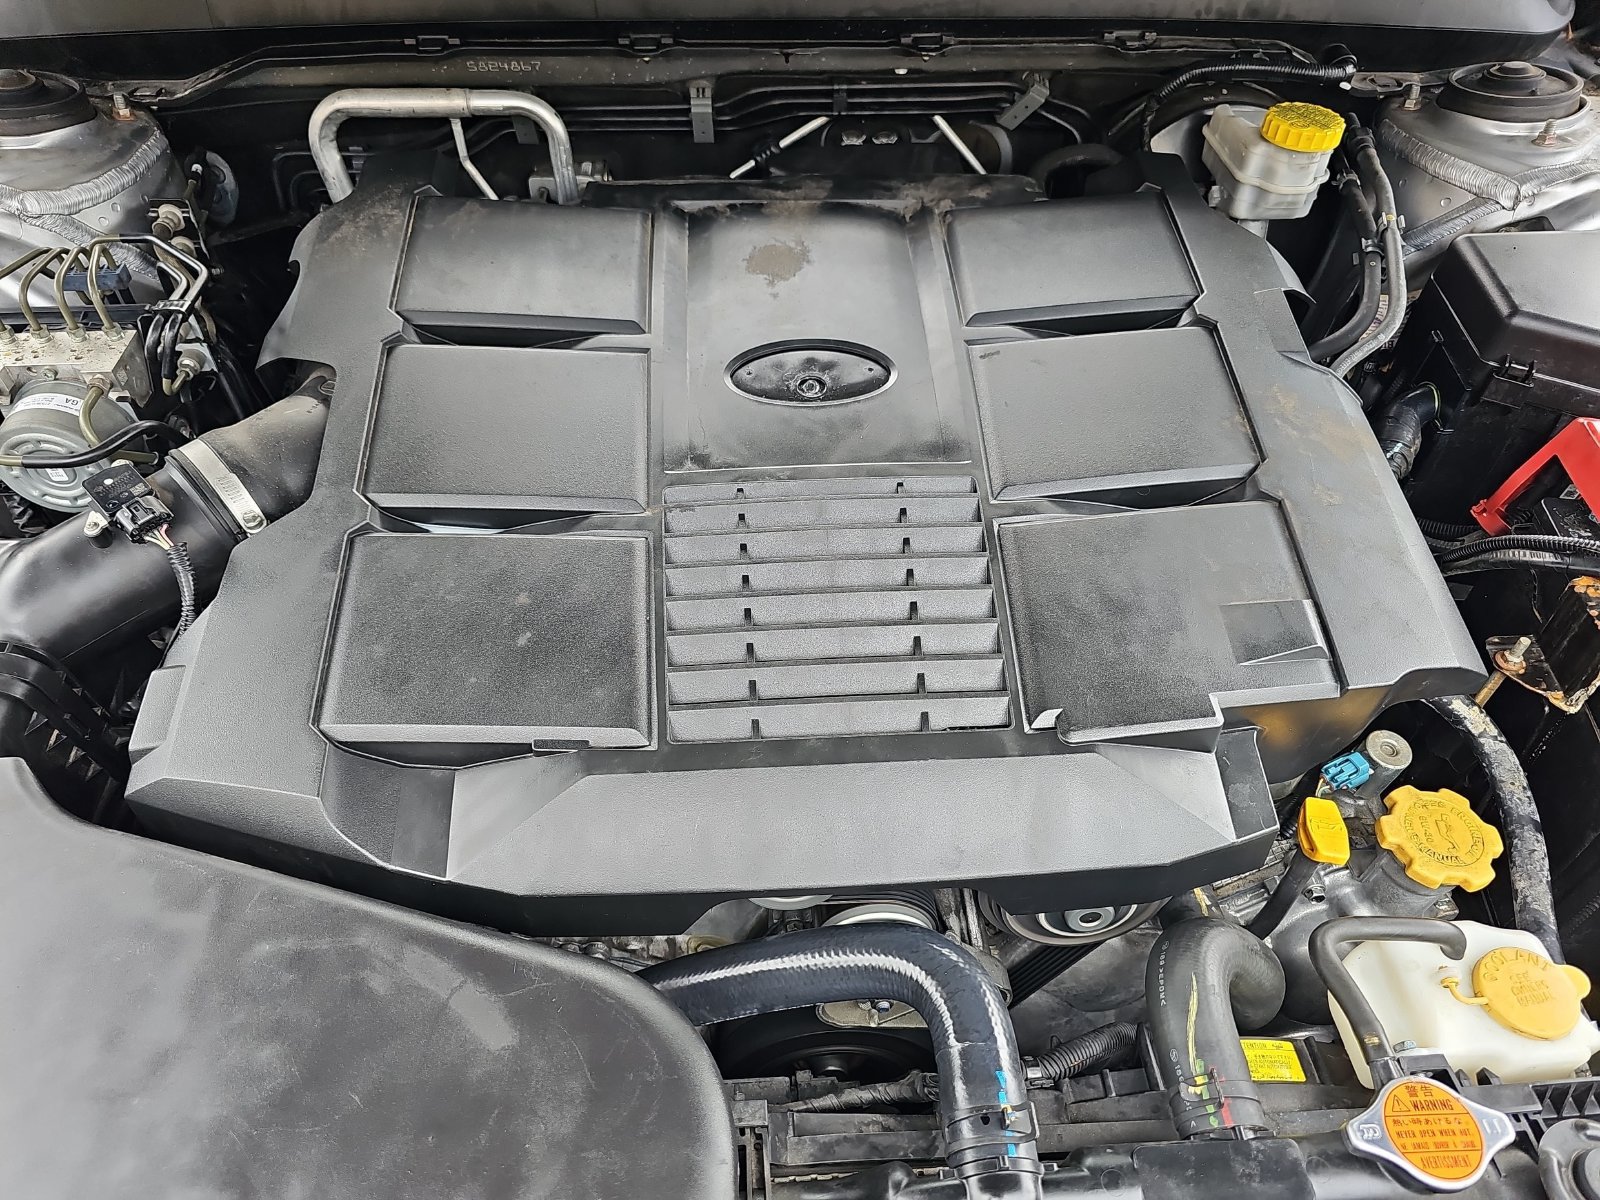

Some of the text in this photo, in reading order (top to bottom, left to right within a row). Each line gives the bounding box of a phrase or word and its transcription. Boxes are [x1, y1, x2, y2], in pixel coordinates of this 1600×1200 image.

[65, 397, 79, 406] GA
[1483, 950, 1551, 982] COOLANT
[1405, 1085, 1433, 1098] 警告
[1410, 1098, 1454, 1112] WARNING
[1395, 1129, 1417, 1139] NEVER
[1419, 1129, 1436, 1138] OPEN
[1439, 1128, 1457, 1138] WHEN
